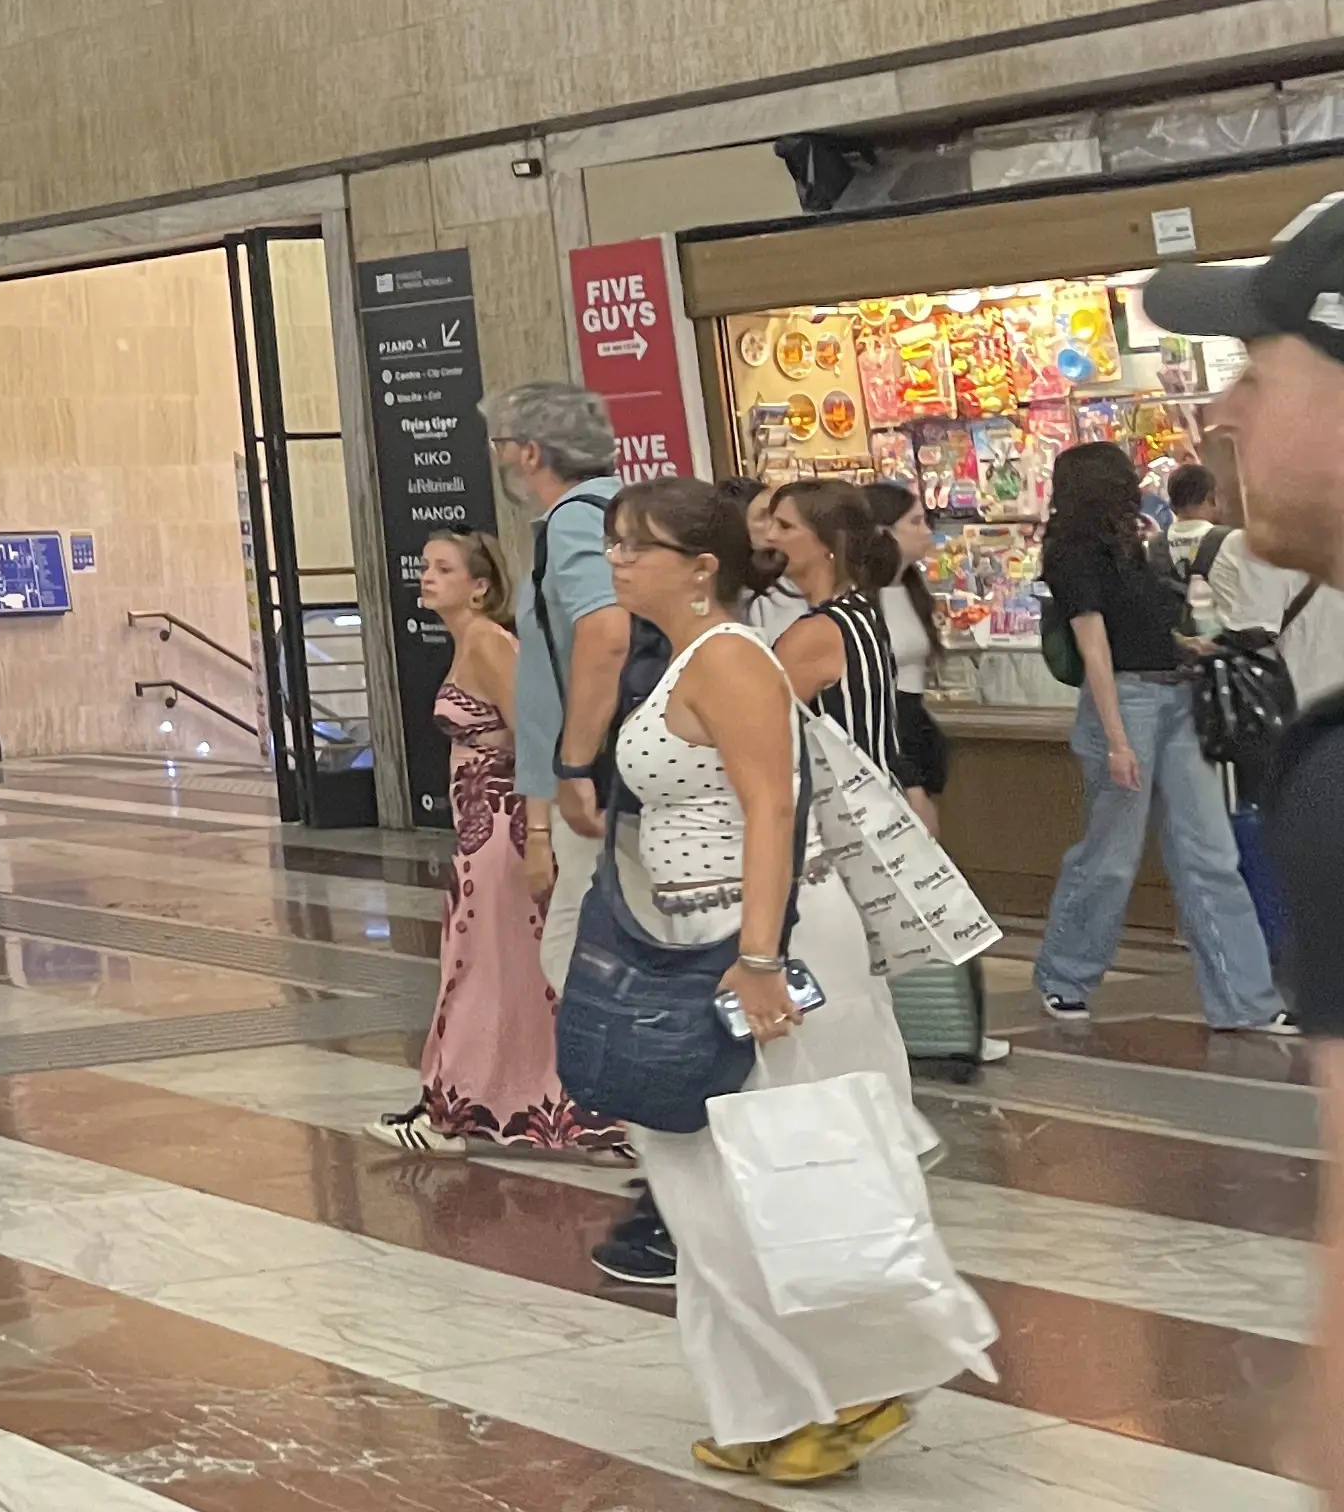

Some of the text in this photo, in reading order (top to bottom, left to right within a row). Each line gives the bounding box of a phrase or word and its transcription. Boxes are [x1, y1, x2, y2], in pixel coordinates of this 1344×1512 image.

[585, 274, 646, 306] FIVE
[582, 301, 657, 334] GUYS
[378, 340, 414, 354] PIANO
[413, 450, 452, 466] KIKO
[411, 505, 466, 521] MANGO
